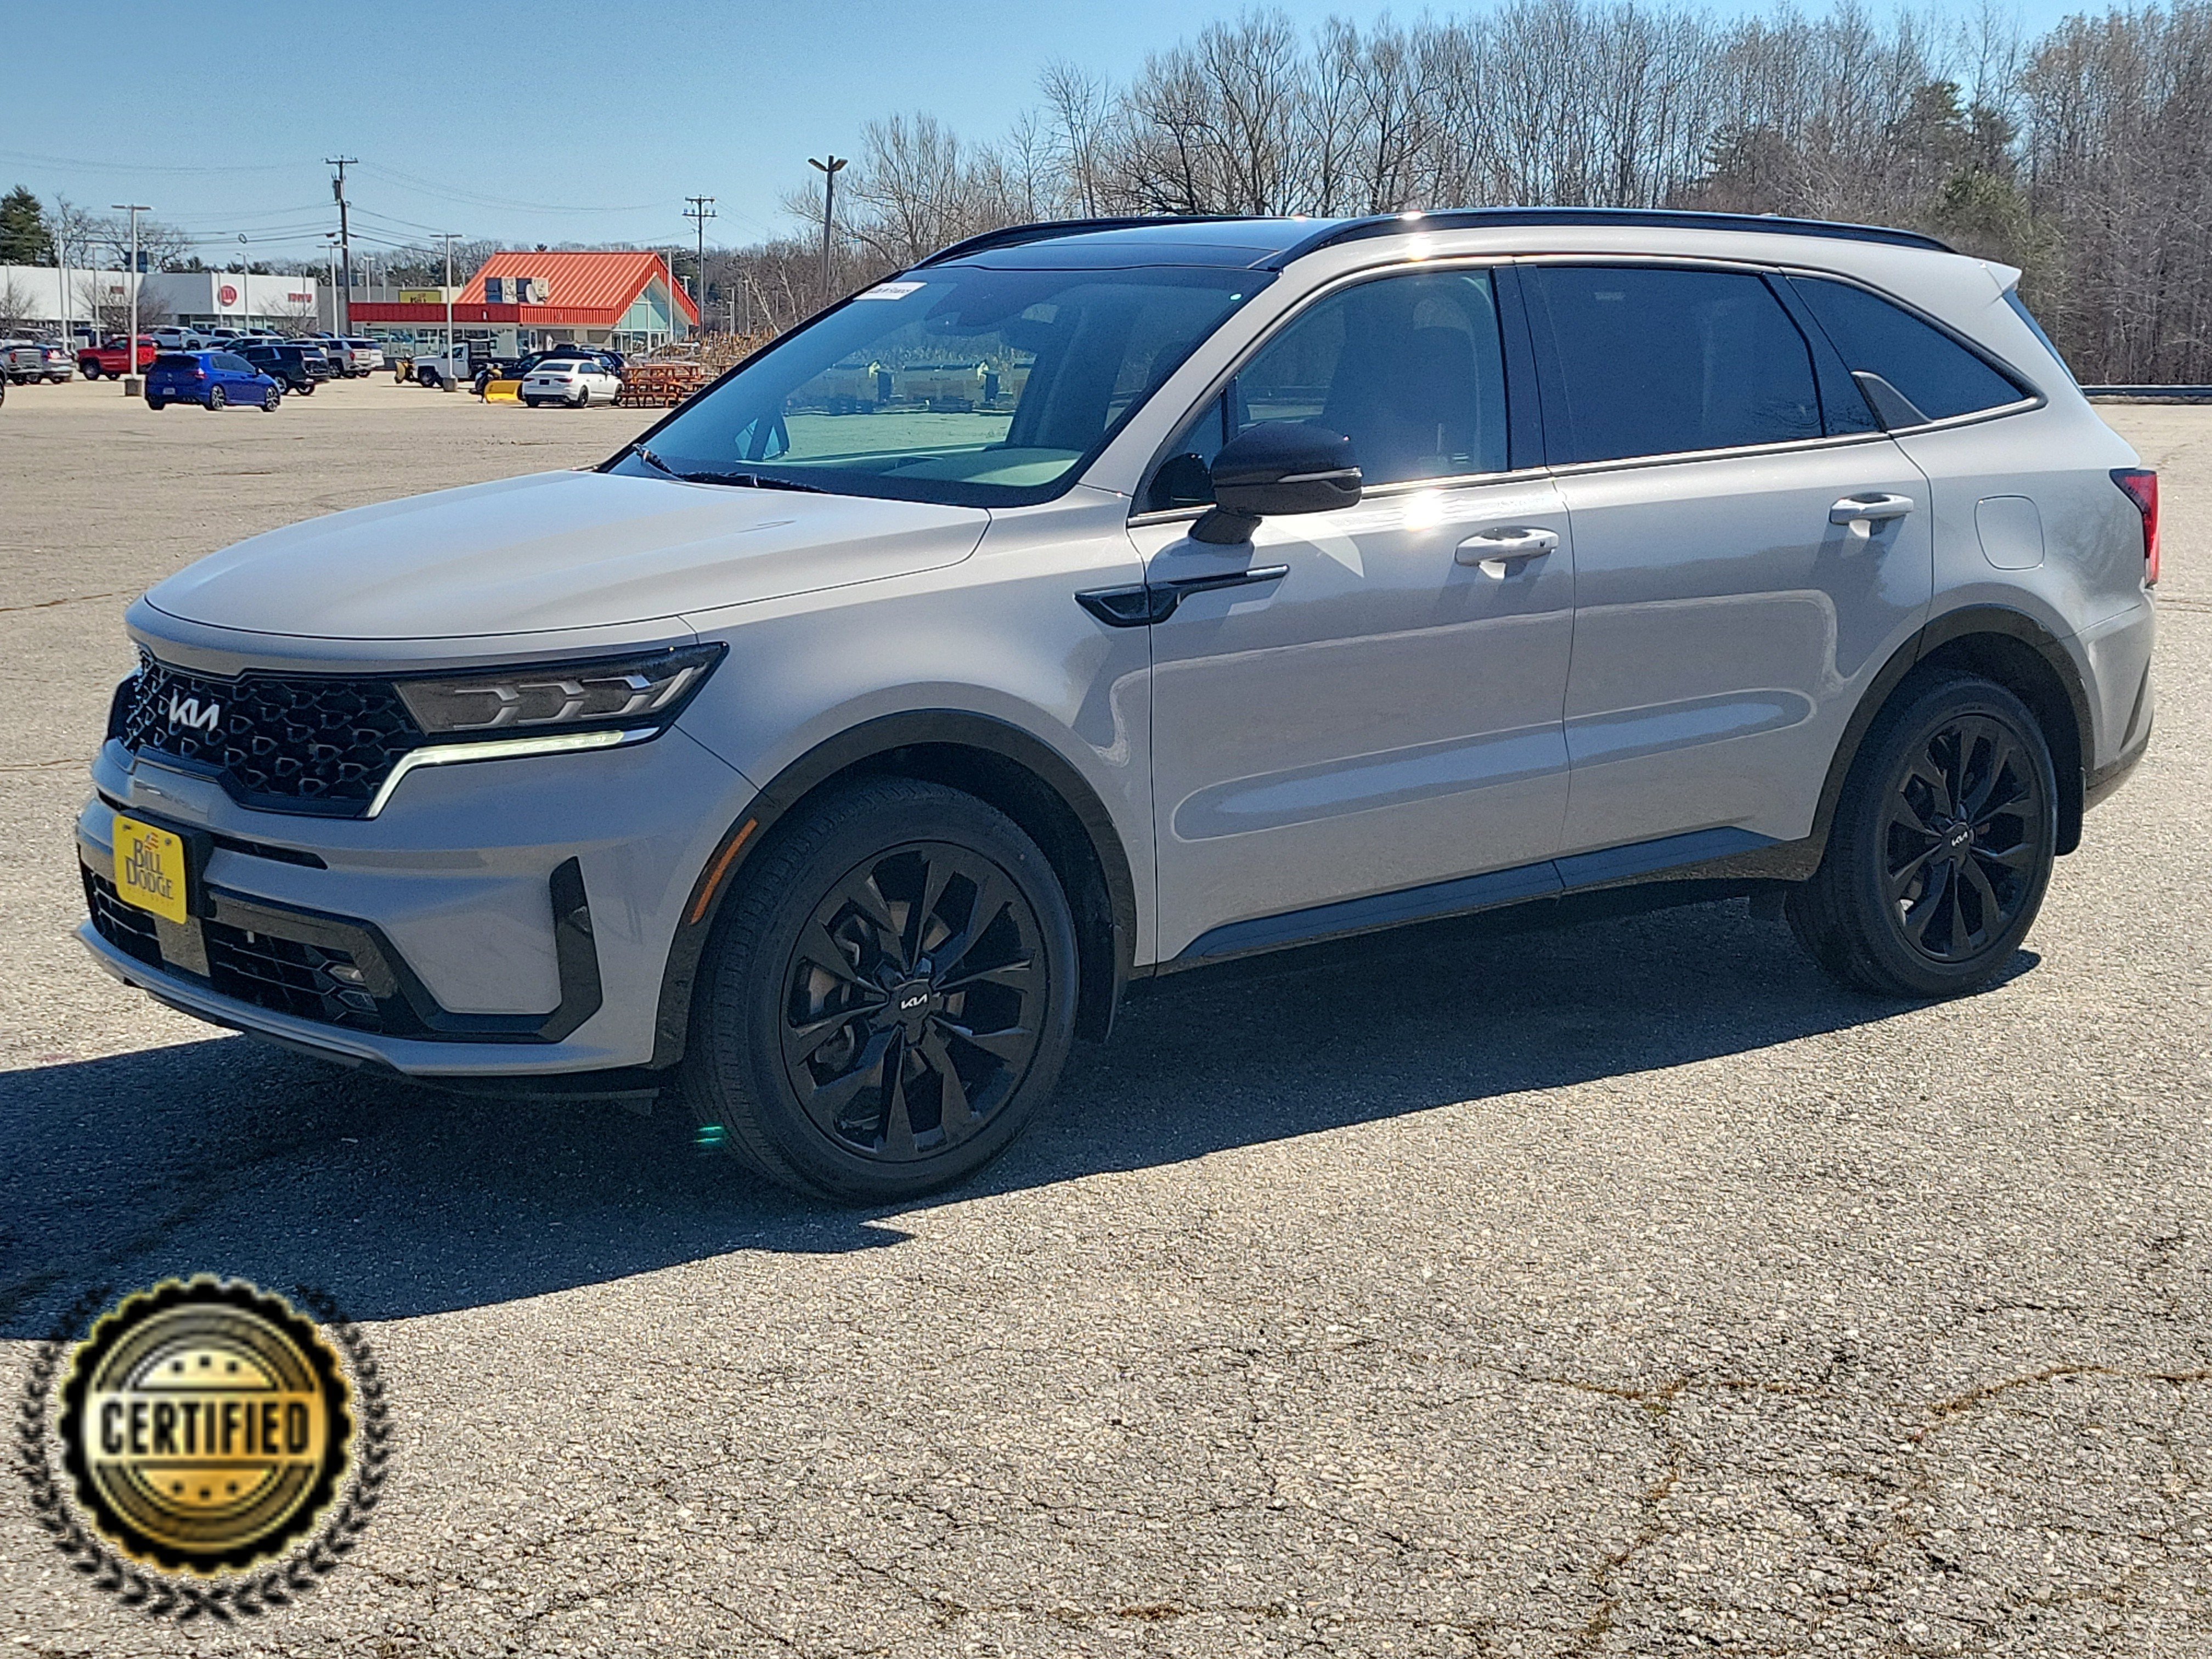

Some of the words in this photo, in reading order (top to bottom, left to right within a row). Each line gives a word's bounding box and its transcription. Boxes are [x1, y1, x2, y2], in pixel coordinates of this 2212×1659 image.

[169, 692, 219, 731] KIA
[133, 838, 163, 875] BILL
[125, 855, 174, 900] DODGE
[901, 994, 927, 1009] KIA
